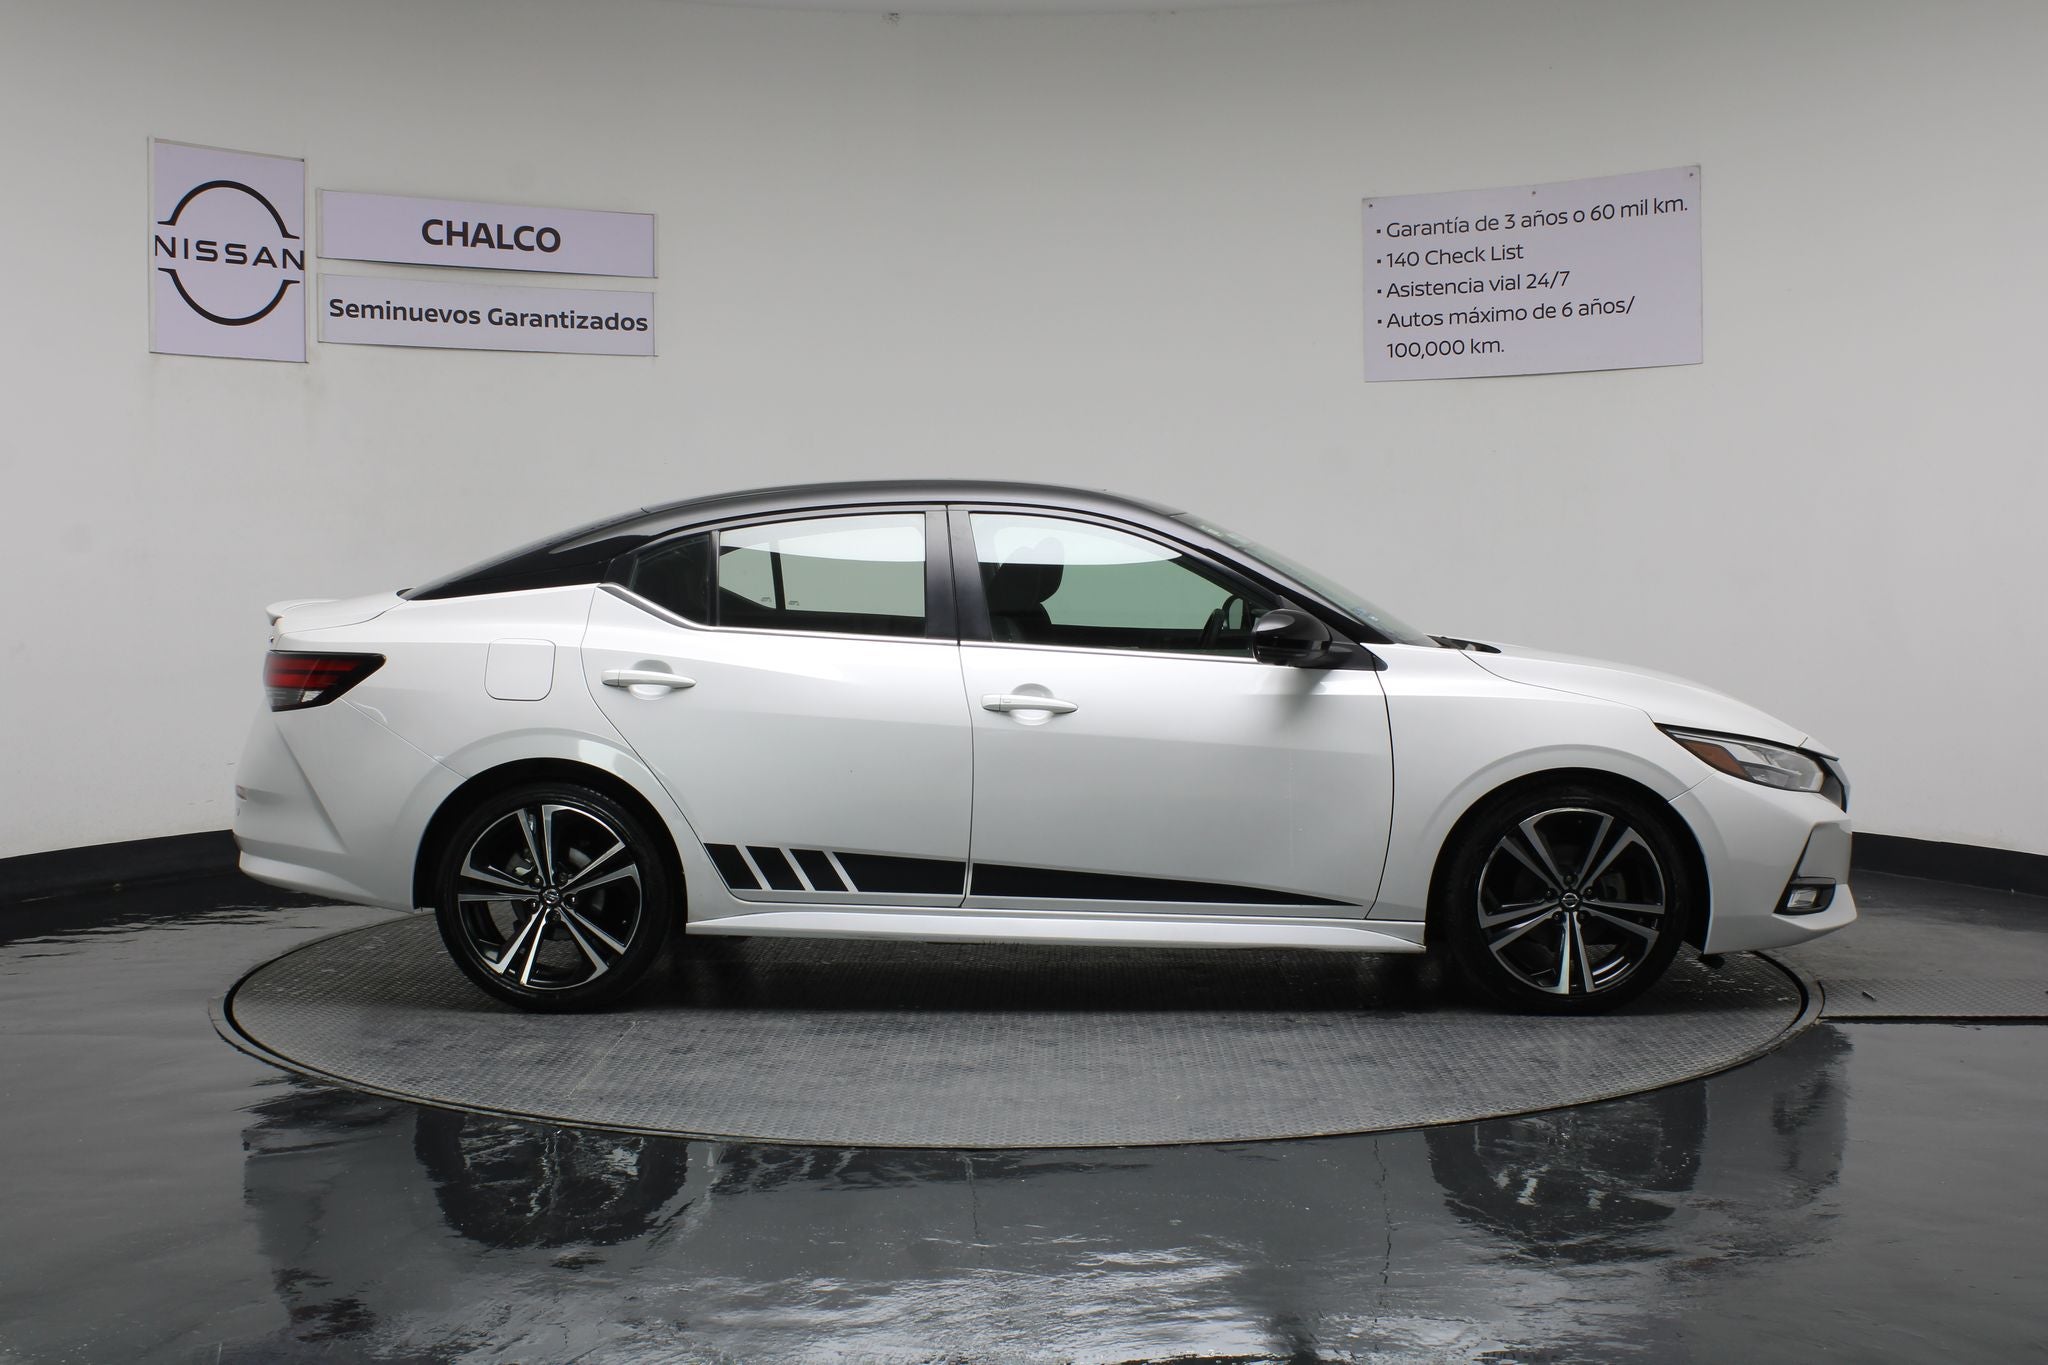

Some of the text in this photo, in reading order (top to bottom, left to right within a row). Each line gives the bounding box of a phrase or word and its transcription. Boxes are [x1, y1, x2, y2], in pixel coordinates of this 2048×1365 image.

[1387, 198, 1687, 237] Garantía de 3 años o 60 mil km.
[422, 219, 561, 253] CHALCO
[155, 235, 304, 271] NISSAN
[1387, 244, 1524, 267] 140 Check List
[1387, 271, 1570, 298] Asistencia vial 24/7
[330, 299, 648, 331] Seminuevos Garantizados
[1387, 296, 1635, 328] Autos máximo de 6 años/
[1387, 338, 1504, 359] 100,000 km.
